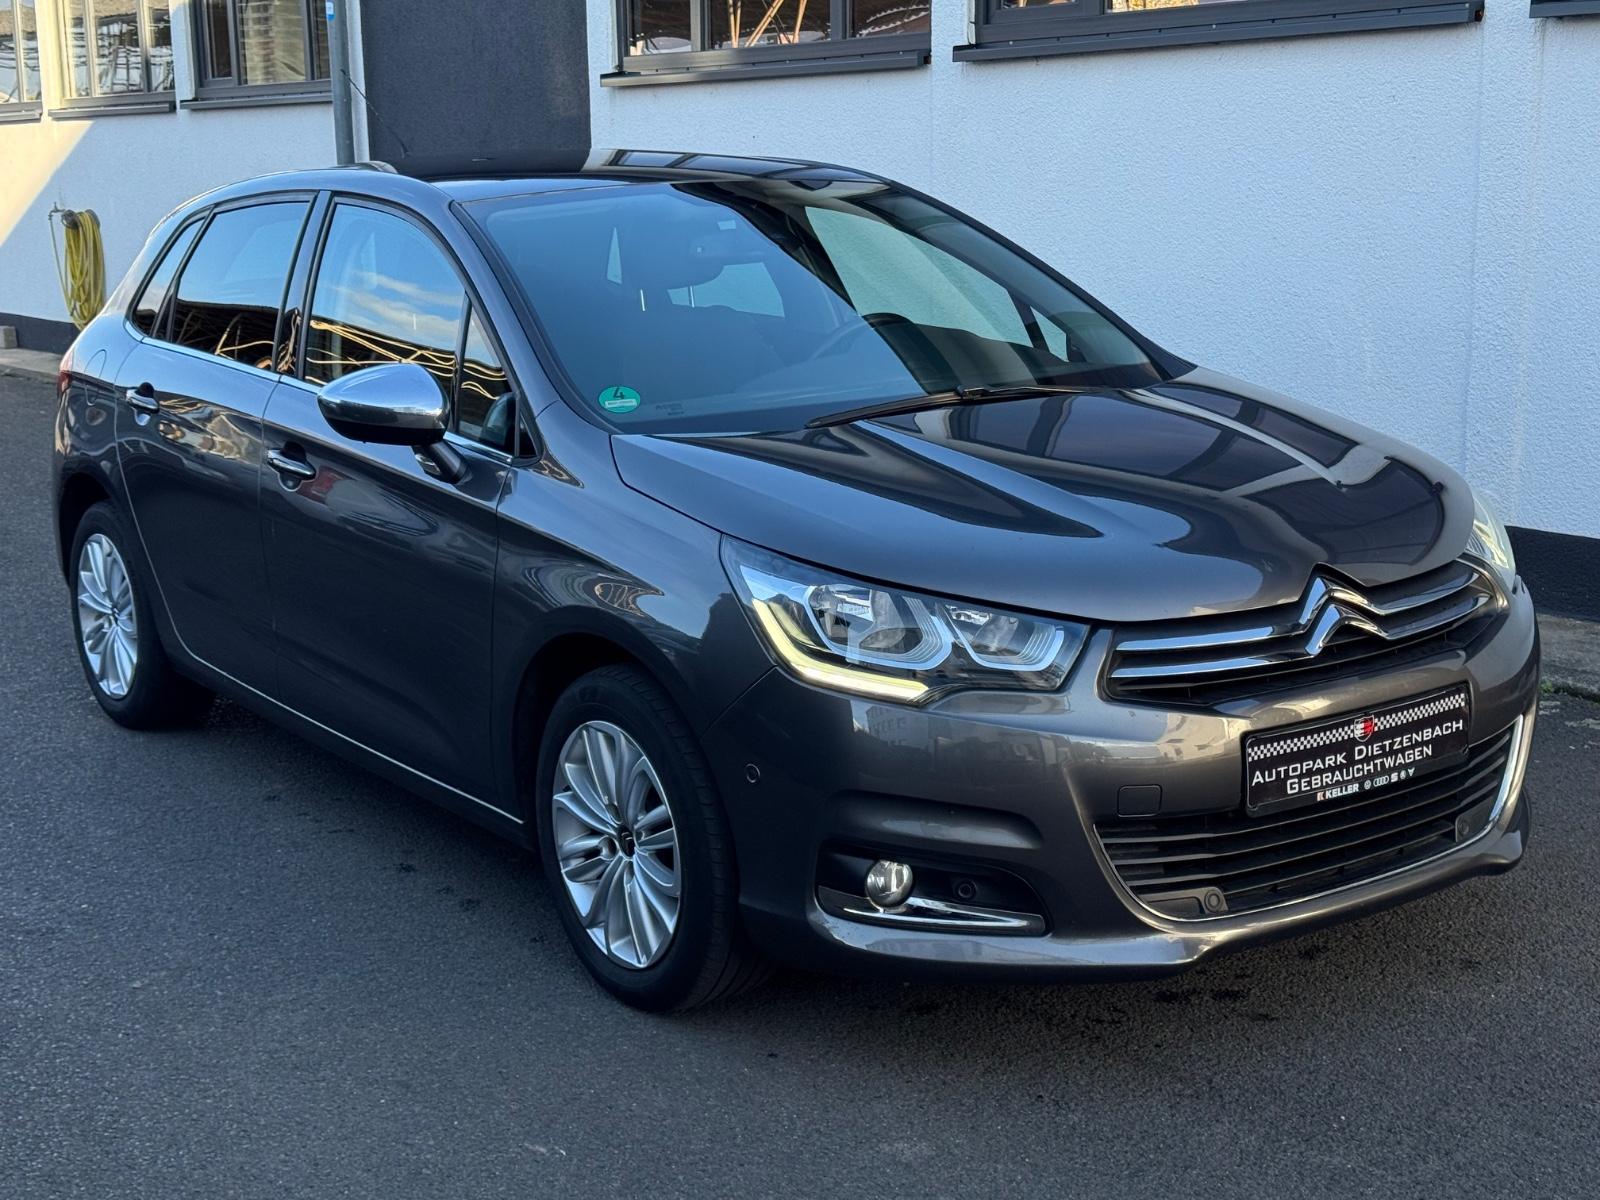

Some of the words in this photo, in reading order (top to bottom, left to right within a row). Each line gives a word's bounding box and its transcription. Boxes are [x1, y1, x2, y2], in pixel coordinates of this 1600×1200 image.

[613, 387, 625, 400] 4
[1251, 752, 1348, 786] AUTOPARK
[1354, 719, 1463, 760] DIETZENBACH
[1286, 744, 1433, 795] GEBRAUCHTWAGEN
[1325, 783, 1360, 800] KELLER
